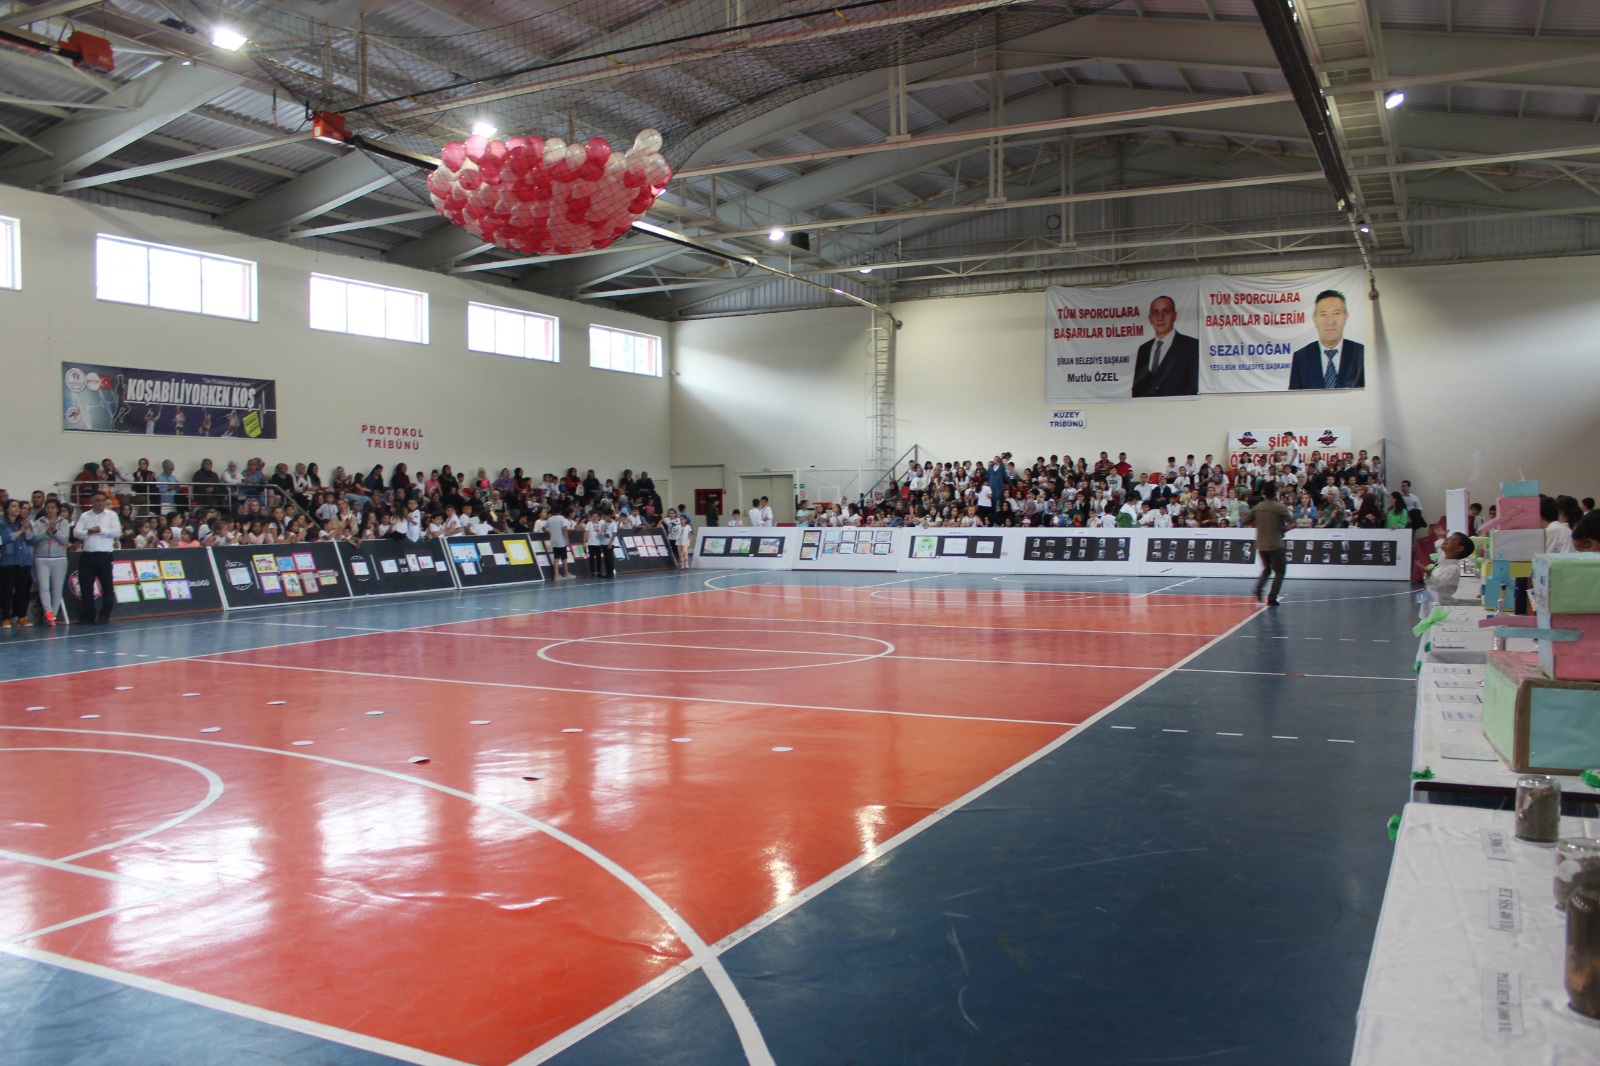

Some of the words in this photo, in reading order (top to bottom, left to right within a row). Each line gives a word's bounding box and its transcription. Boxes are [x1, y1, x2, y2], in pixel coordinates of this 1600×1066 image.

[1209, 291, 1231, 305] TÜM
[1233, 292, 1301, 305] SPORCULARA
[1057, 306, 1077, 319] TÜM
[1079, 306, 1140, 319] SPORCULARA
[1206, 313, 1260, 329] BAŞARILAR
[1263, 310, 1305, 326] DİLERİM
[1054, 327, 1103, 341] BAŞARILAR
[1106, 323, 1144, 338] DİLERİM
[1210, 342, 1244, 356] SEZAİ
[1248, 341, 1291, 355] DOĞAN
[1075, 355, 1102, 365] BELEDİYE
[1104, 355, 1130, 366] BAŞKANI
[1238, 363, 1265, 371] BELEDİYE
[1266, 363, 1291, 371] BAŞKANI
[1067, 373, 1092, 382] Mutlu
[1094, 371, 1119, 382] ÖZEL
[126, 378, 230, 407] KOŞABİLİYORKEN
[232, 387, 257, 412] KOŞ
[1049, 419, 1084, 427] TRİBÜNÜ
[361, 424, 424, 438] PROTOKOL
[367, 438, 419, 450] TRİBÜNÜ
